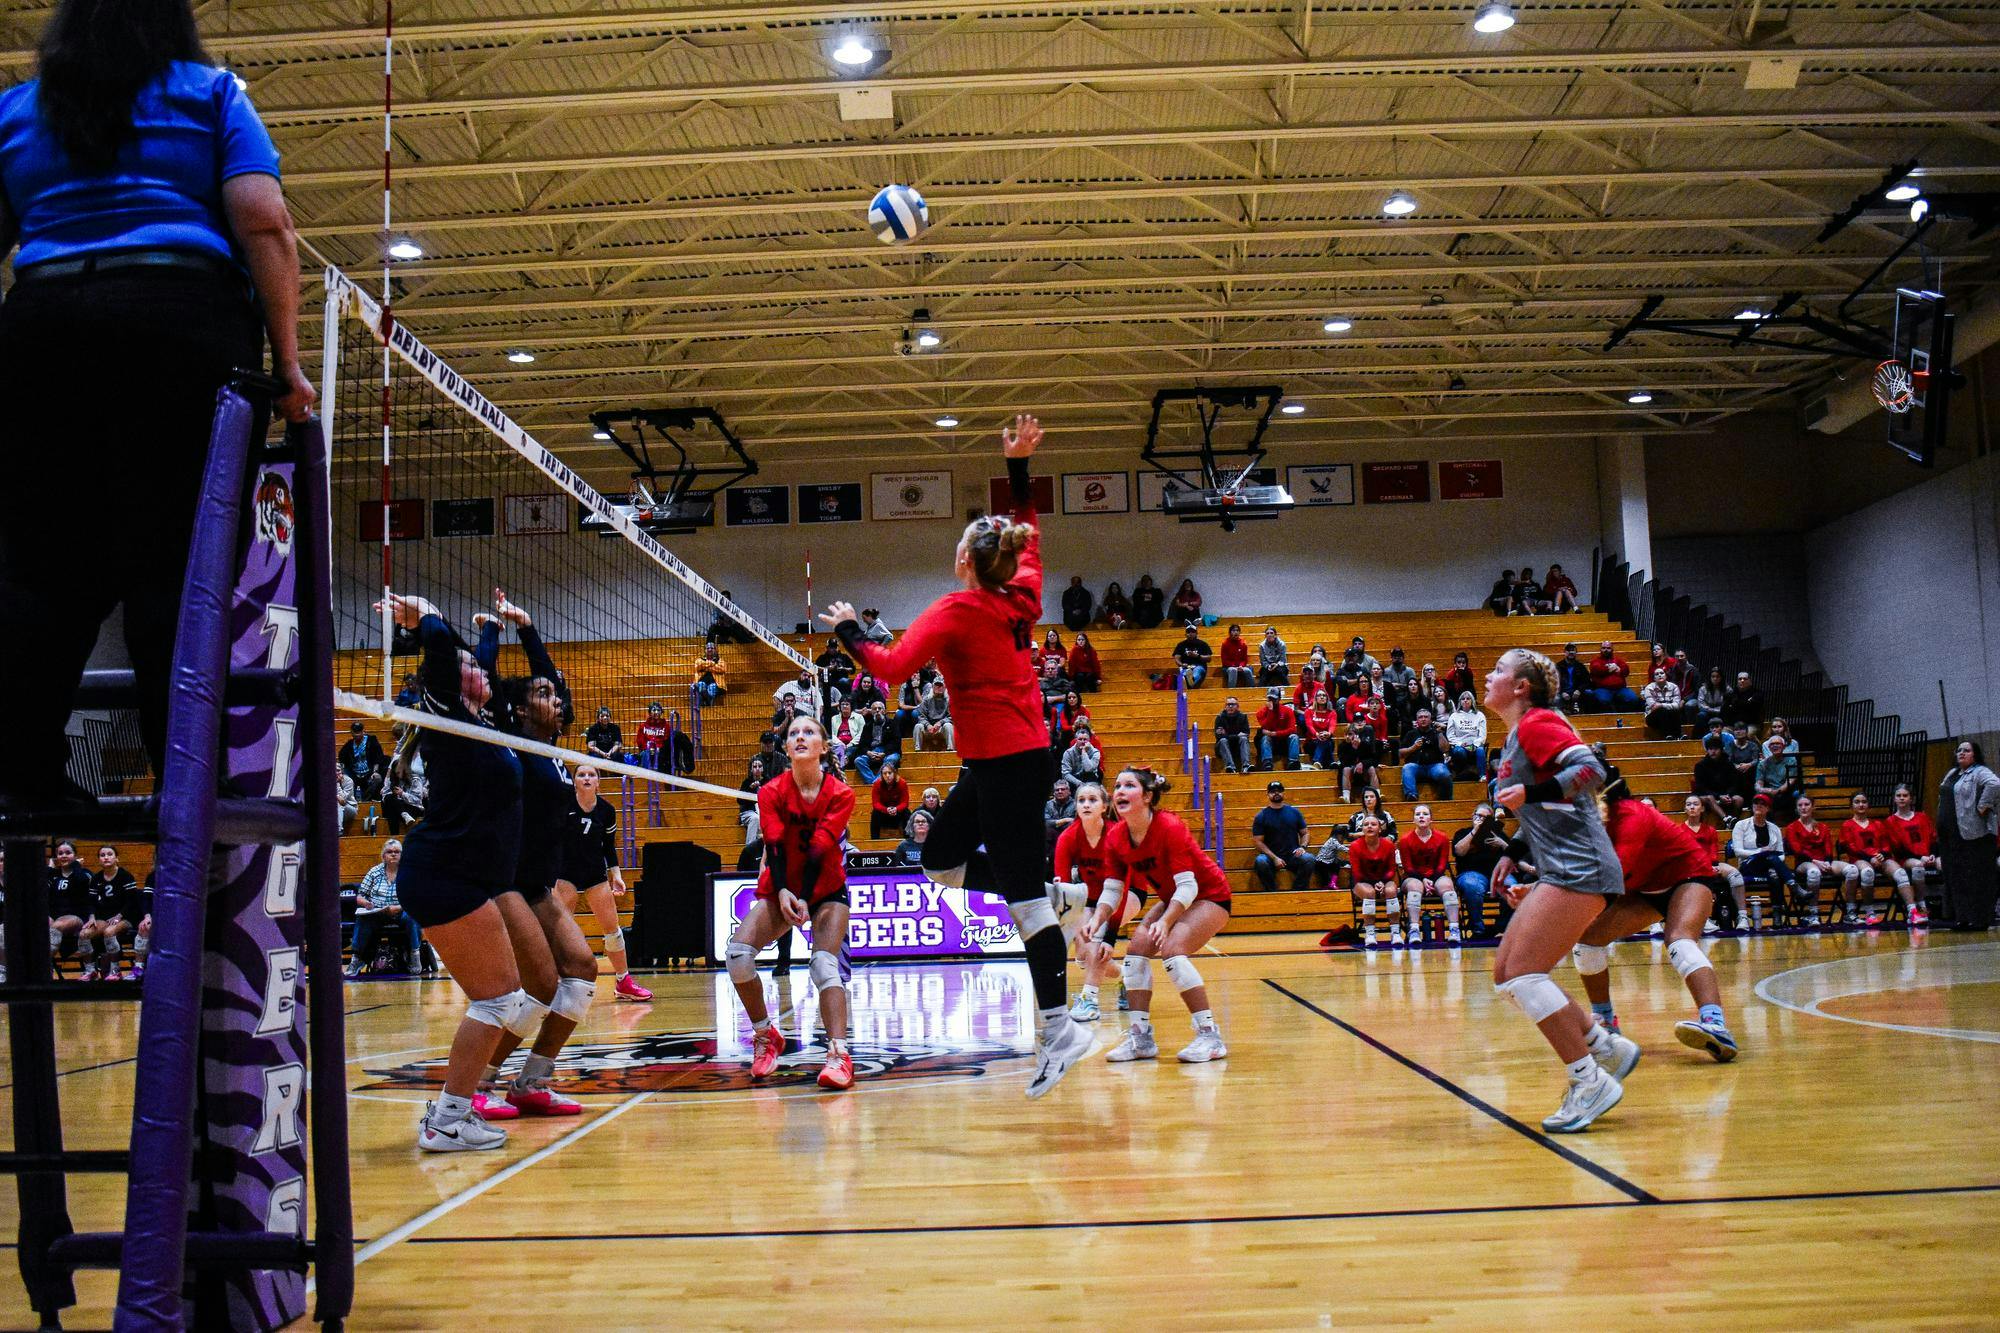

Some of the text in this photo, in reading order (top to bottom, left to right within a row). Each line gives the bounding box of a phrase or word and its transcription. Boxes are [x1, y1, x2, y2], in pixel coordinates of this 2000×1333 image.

[391, 323, 506, 434] HELBY VOLLEYBALL
[580, 817, 593, 835] 7
[862, 857, 880, 867] poss
[57, 879, 70, 891] 16
[104, 884, 114, 897] 2
[848, 882, 946, 914] ELBY
[848, 916, 944, 948] GERS
[960, 923, 1019, 949] Tigers
